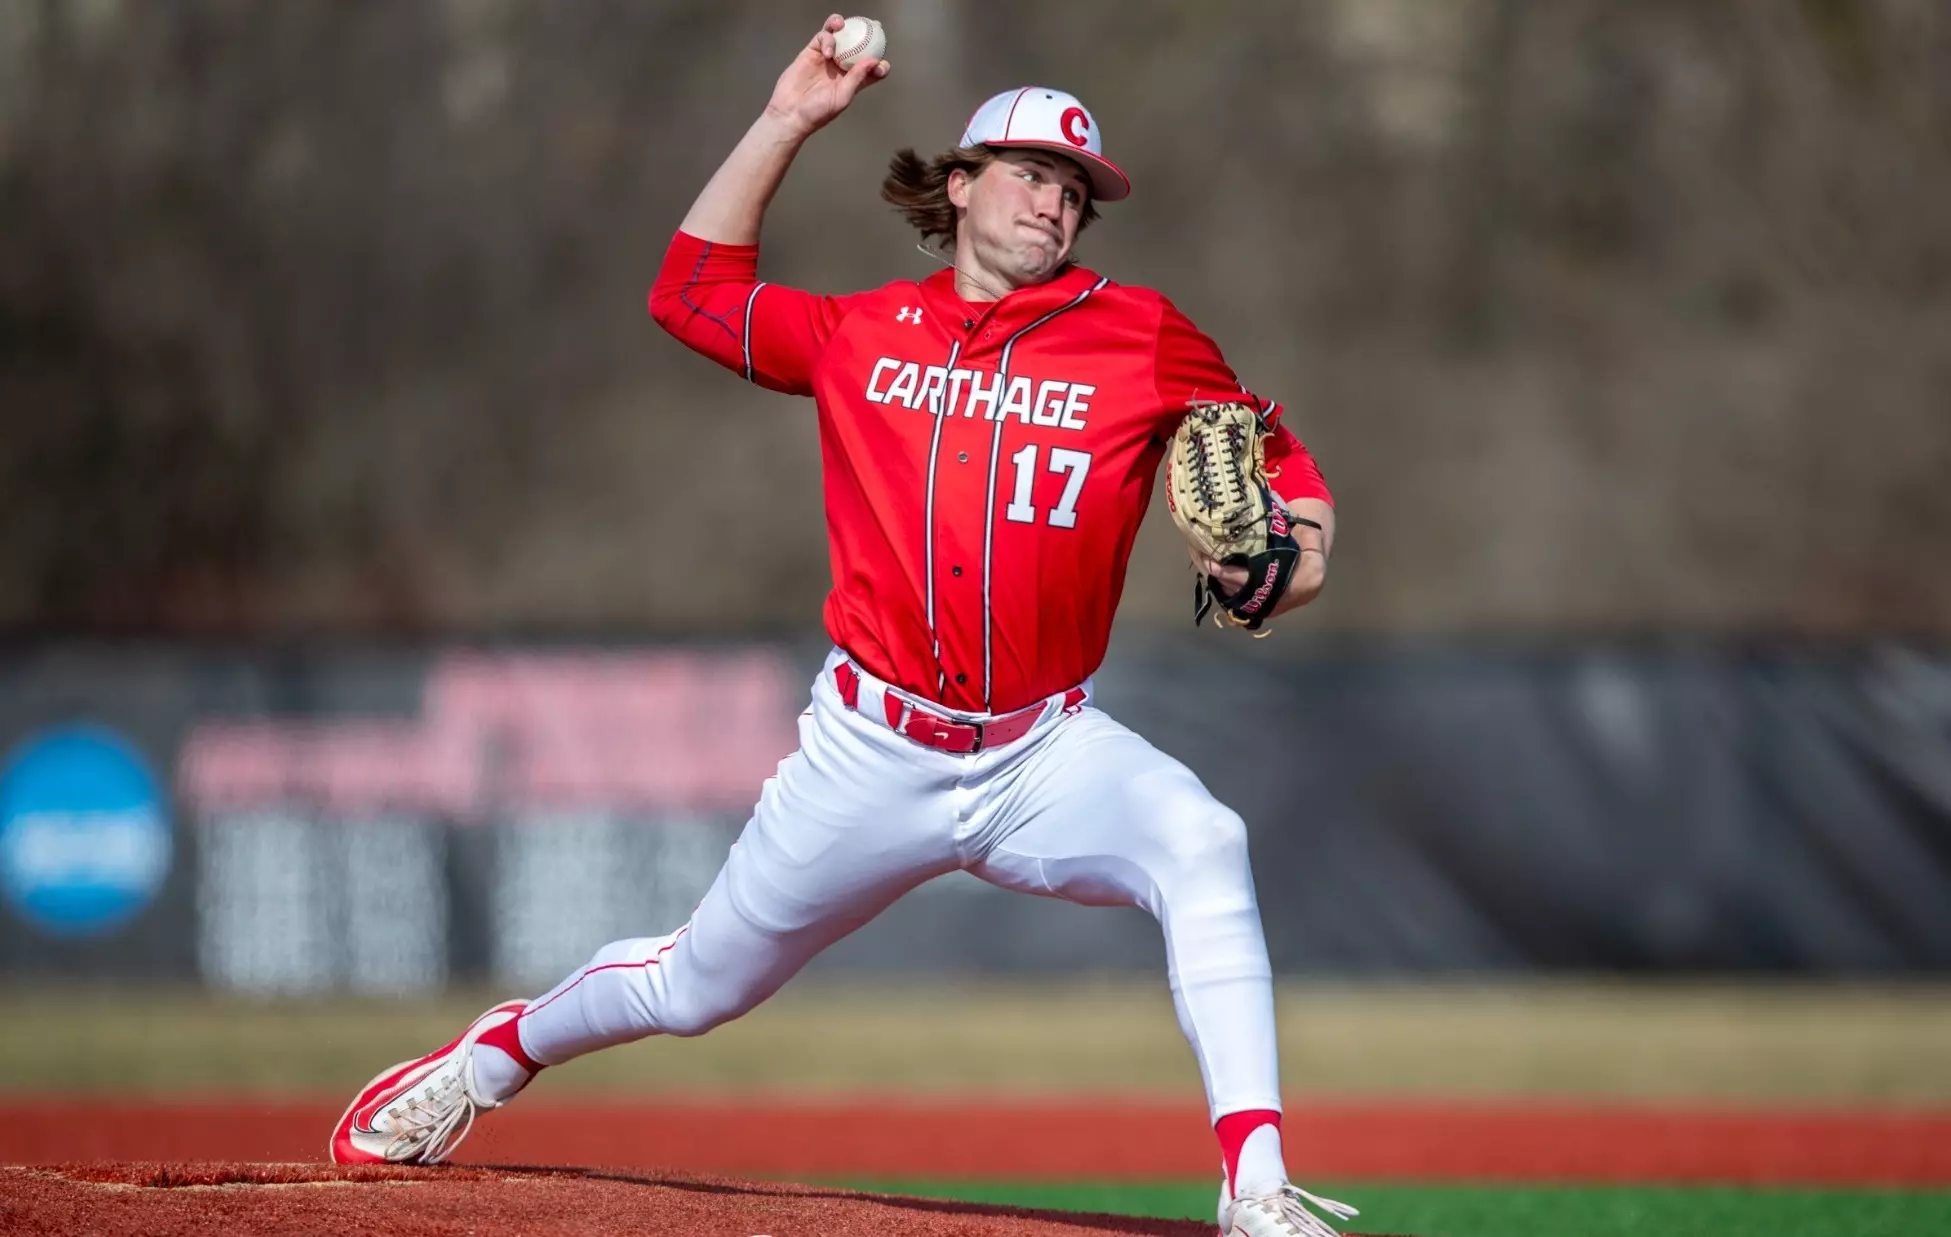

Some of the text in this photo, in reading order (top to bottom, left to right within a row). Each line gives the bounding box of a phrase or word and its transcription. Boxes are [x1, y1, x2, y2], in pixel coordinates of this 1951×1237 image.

[1060, 107, 1089, 147] C
[865, 356, 1097, 431] CARTHAGE
[1006, 444, 1093, 529] 17
[1240, 562, 1279, 614] Wilson
